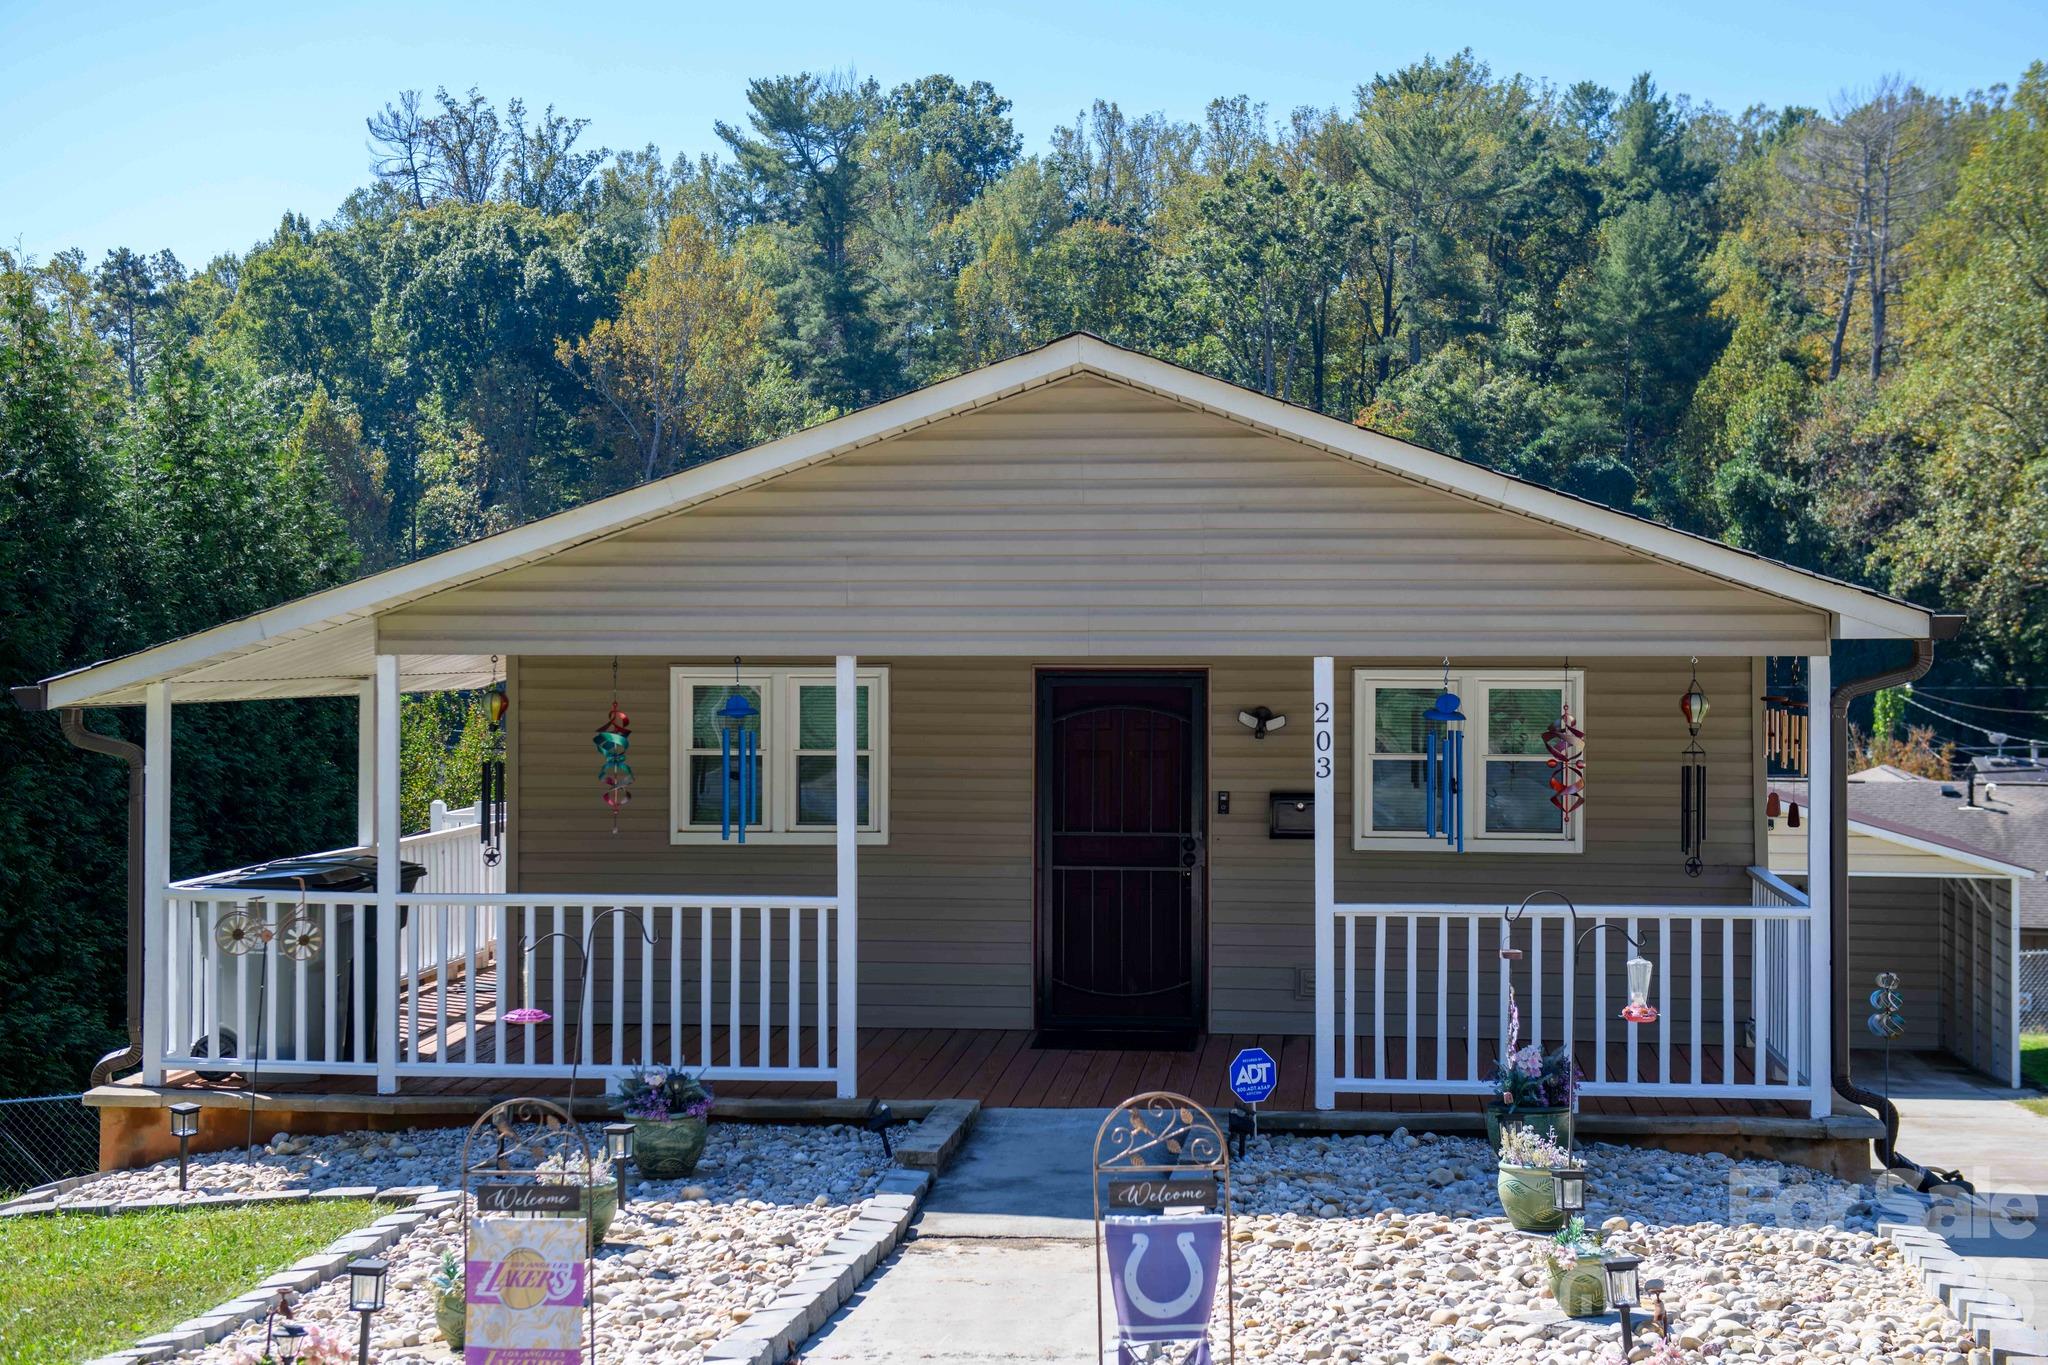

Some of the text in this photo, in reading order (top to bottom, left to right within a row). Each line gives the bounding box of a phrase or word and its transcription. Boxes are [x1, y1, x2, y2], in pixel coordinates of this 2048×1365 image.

[1314, 702, 1331, 778] 203
[1235, 1062, 1271, 1086] ADT
[486, 1186, 569, 1210] Welcome
[1118, 1182, 1206, 1206] Welcome
[484, 1261, 572, 1297] LAKERS
